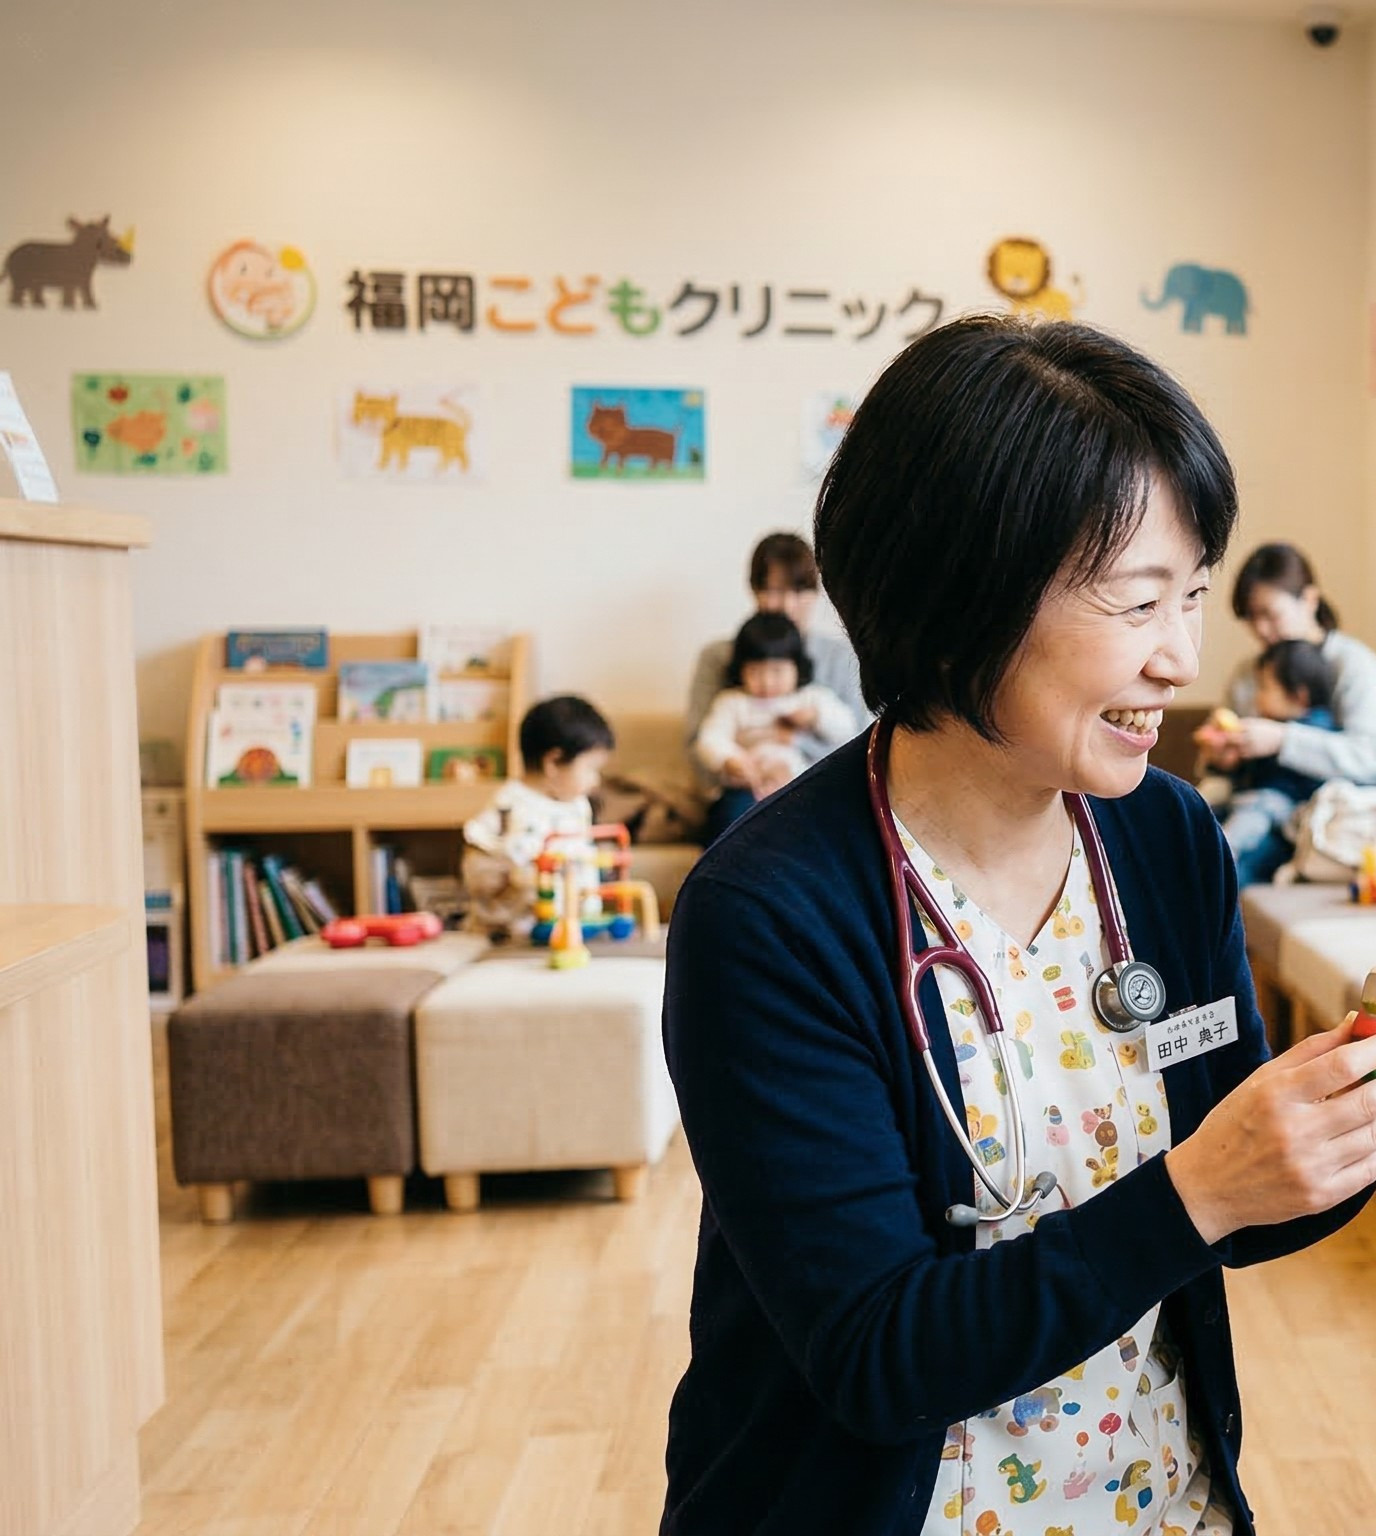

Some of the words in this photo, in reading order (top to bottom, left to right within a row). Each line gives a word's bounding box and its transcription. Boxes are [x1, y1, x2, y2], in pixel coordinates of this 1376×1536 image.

[345, 269, 948, 342] 福岡こどもクリニック
[1157, 1035, 1188, 1060] 田中
